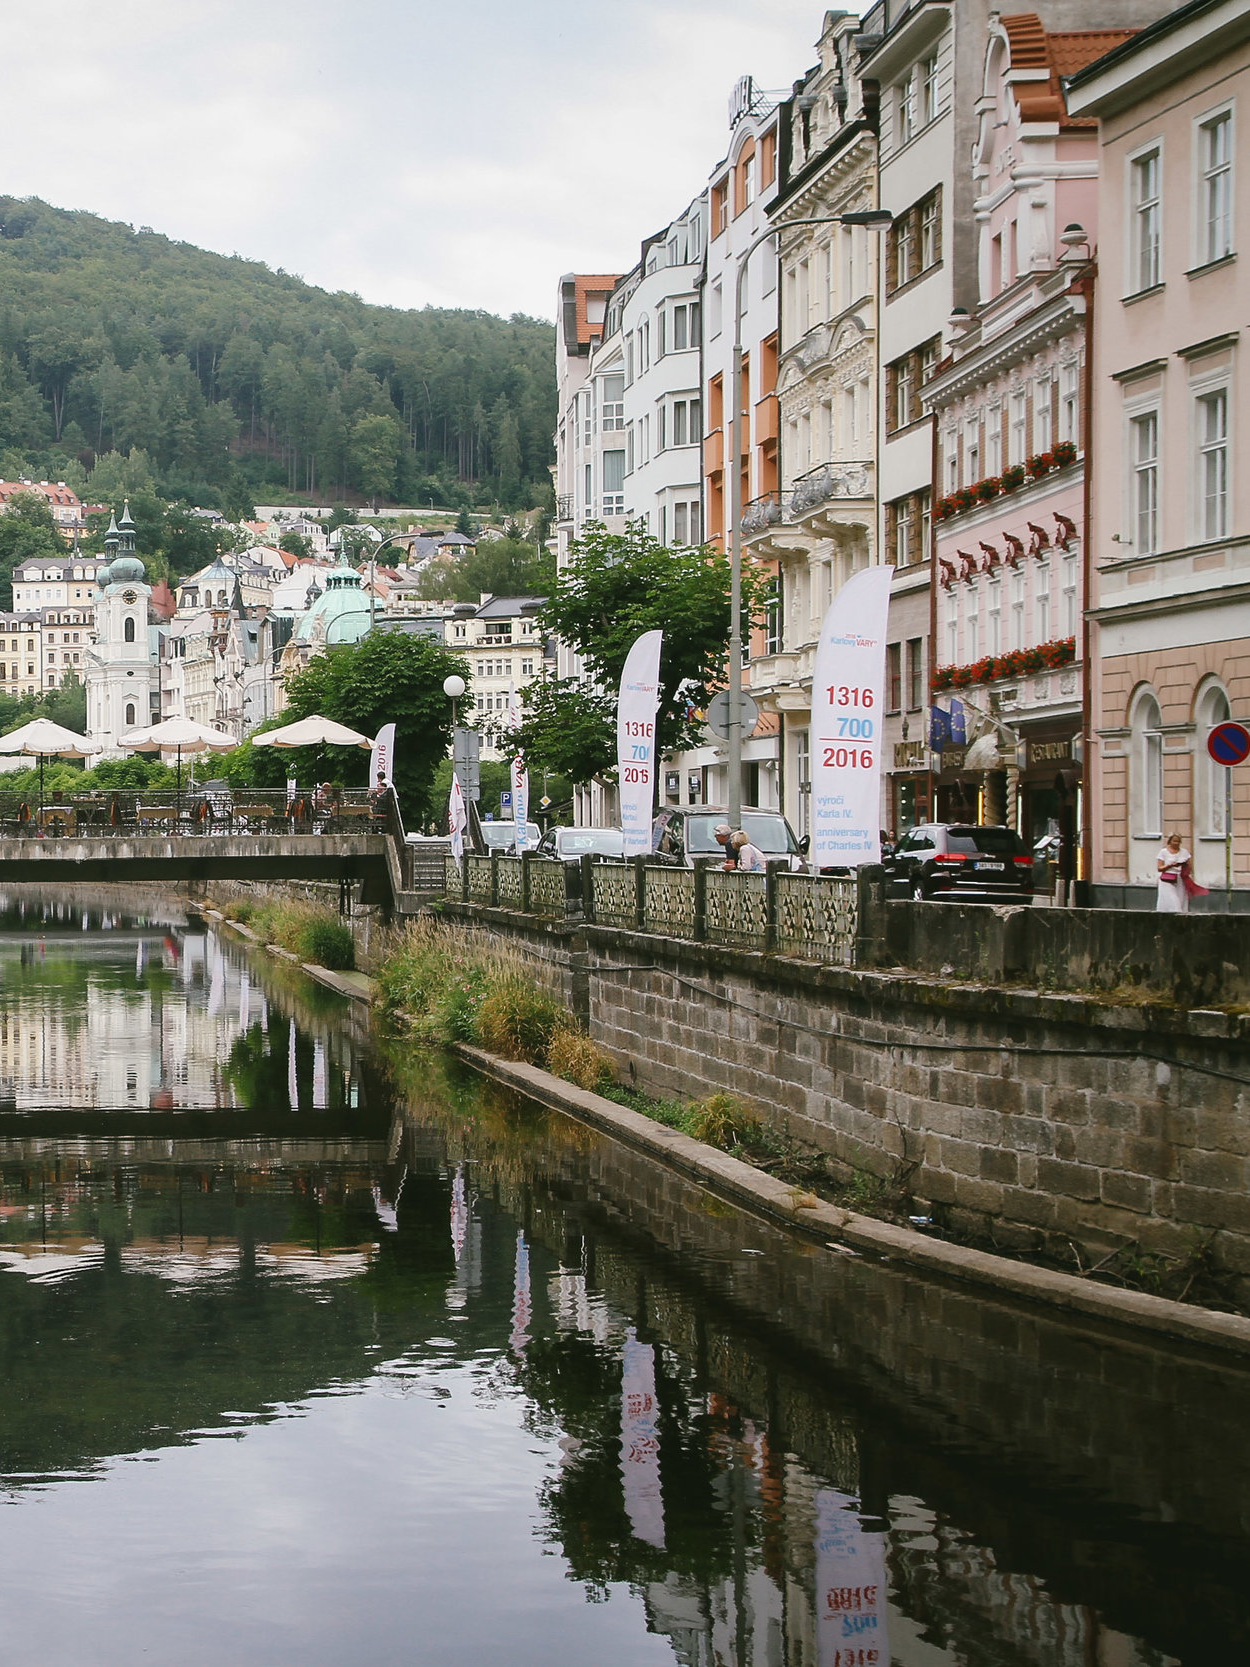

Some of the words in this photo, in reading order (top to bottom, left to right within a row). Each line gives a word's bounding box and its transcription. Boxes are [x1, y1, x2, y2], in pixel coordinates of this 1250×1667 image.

[826, 686, 874, 708] 1316
[625, 721, 654, 738] 1316
[837, 717, 873, 738] 700
[377, 744, 387, 771] 2016
[823, 748, 873, 769] 2016
[502, 794, 510, 803] P
[817, 809, 840, 818] Karla
[816, 828, 869, 838] anniversary
[816, 841, 826, 850] of
[828, 841, 862, 850] Charles
[864, 841, 873, 850] IV
